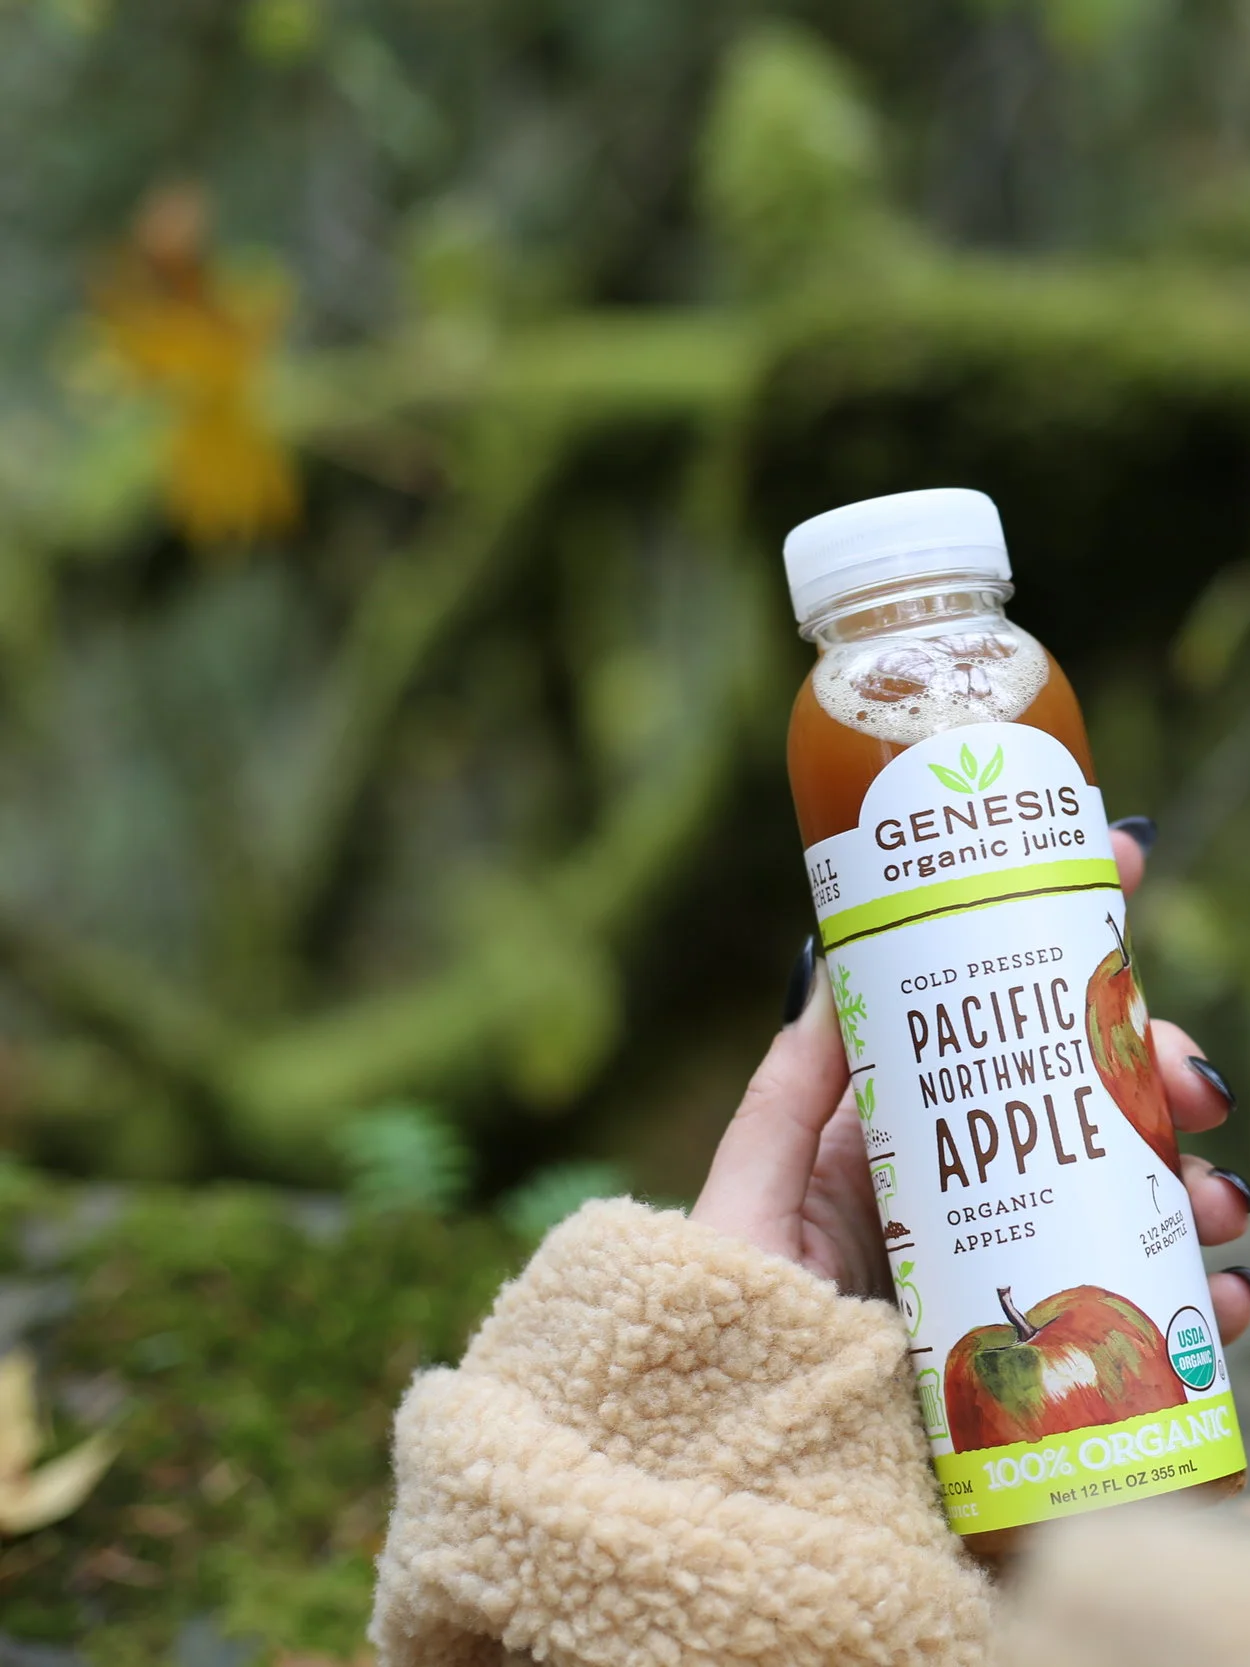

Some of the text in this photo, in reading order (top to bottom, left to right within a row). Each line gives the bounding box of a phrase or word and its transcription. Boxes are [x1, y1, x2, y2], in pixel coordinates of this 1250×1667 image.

[875, 786, 1080, 850] GENESIS
[883, 827, 1085, 882] organic juice
[901, 947, 1063, 994] COLD PRESSED
[907, 978, 1075, 1063] PACIFIC
[919, 1039, 1082, 1108] NORTHWEST
[936, 1086, 1106, 1192] APPLE
[947, 1189, 1054, 1226] ORGANIC
[1140, 1210, 1184, 1244] 2 1/2 APPLES
[953, 1222, 1036, 1254] APPLES
[1145, 1223, 1187, 1258] PER BOTTLE
[1177, 1326, 1205, 1348] USDA
[1179, 1350, 1212, 1371] ORGANIC
[983, 1405, 1233, 1490] 100% ORGANIC
[1050, 1459, 1198, 1505] Net 12 FL OZ 355 mL
